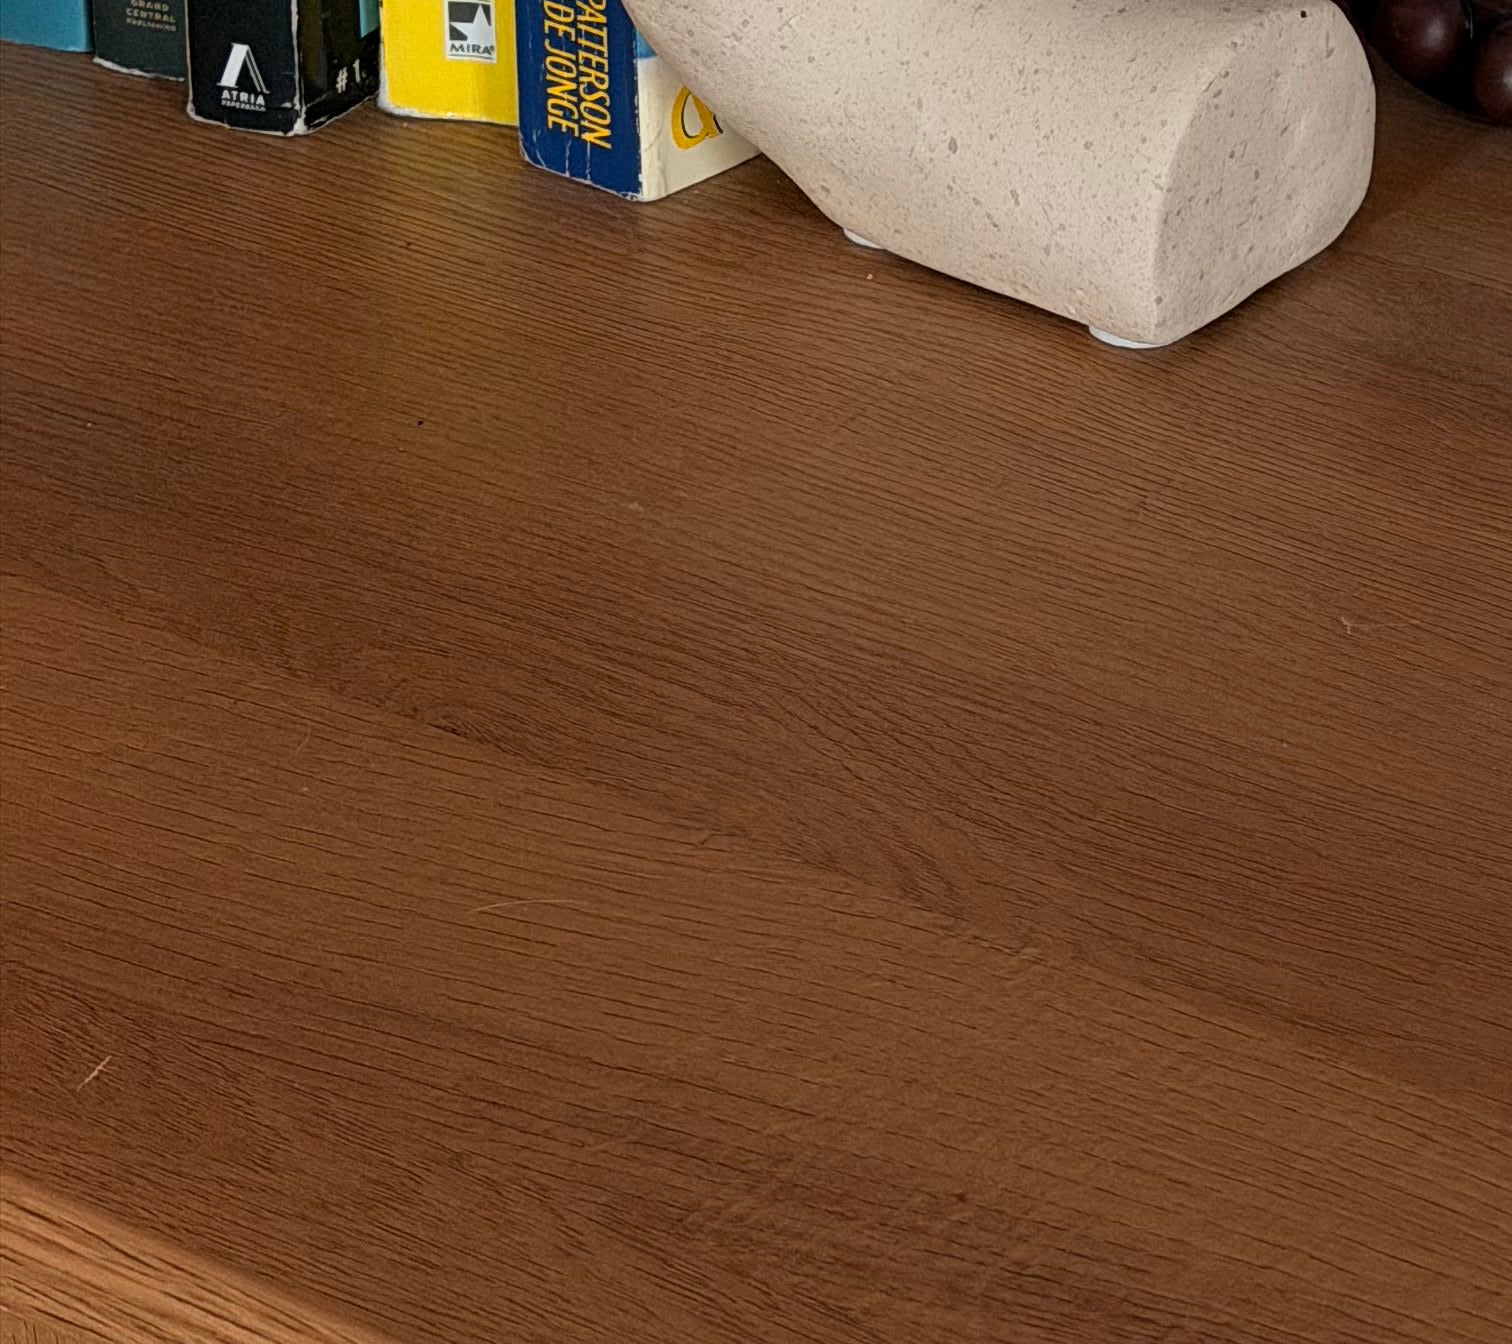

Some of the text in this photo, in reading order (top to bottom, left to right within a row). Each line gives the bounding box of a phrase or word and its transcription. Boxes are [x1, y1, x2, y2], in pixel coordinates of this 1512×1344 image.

[543, 0, 576, 43] DE
[221, 89, 266, 107] ATRIA
[544, 42, 580, 138] JONGE
